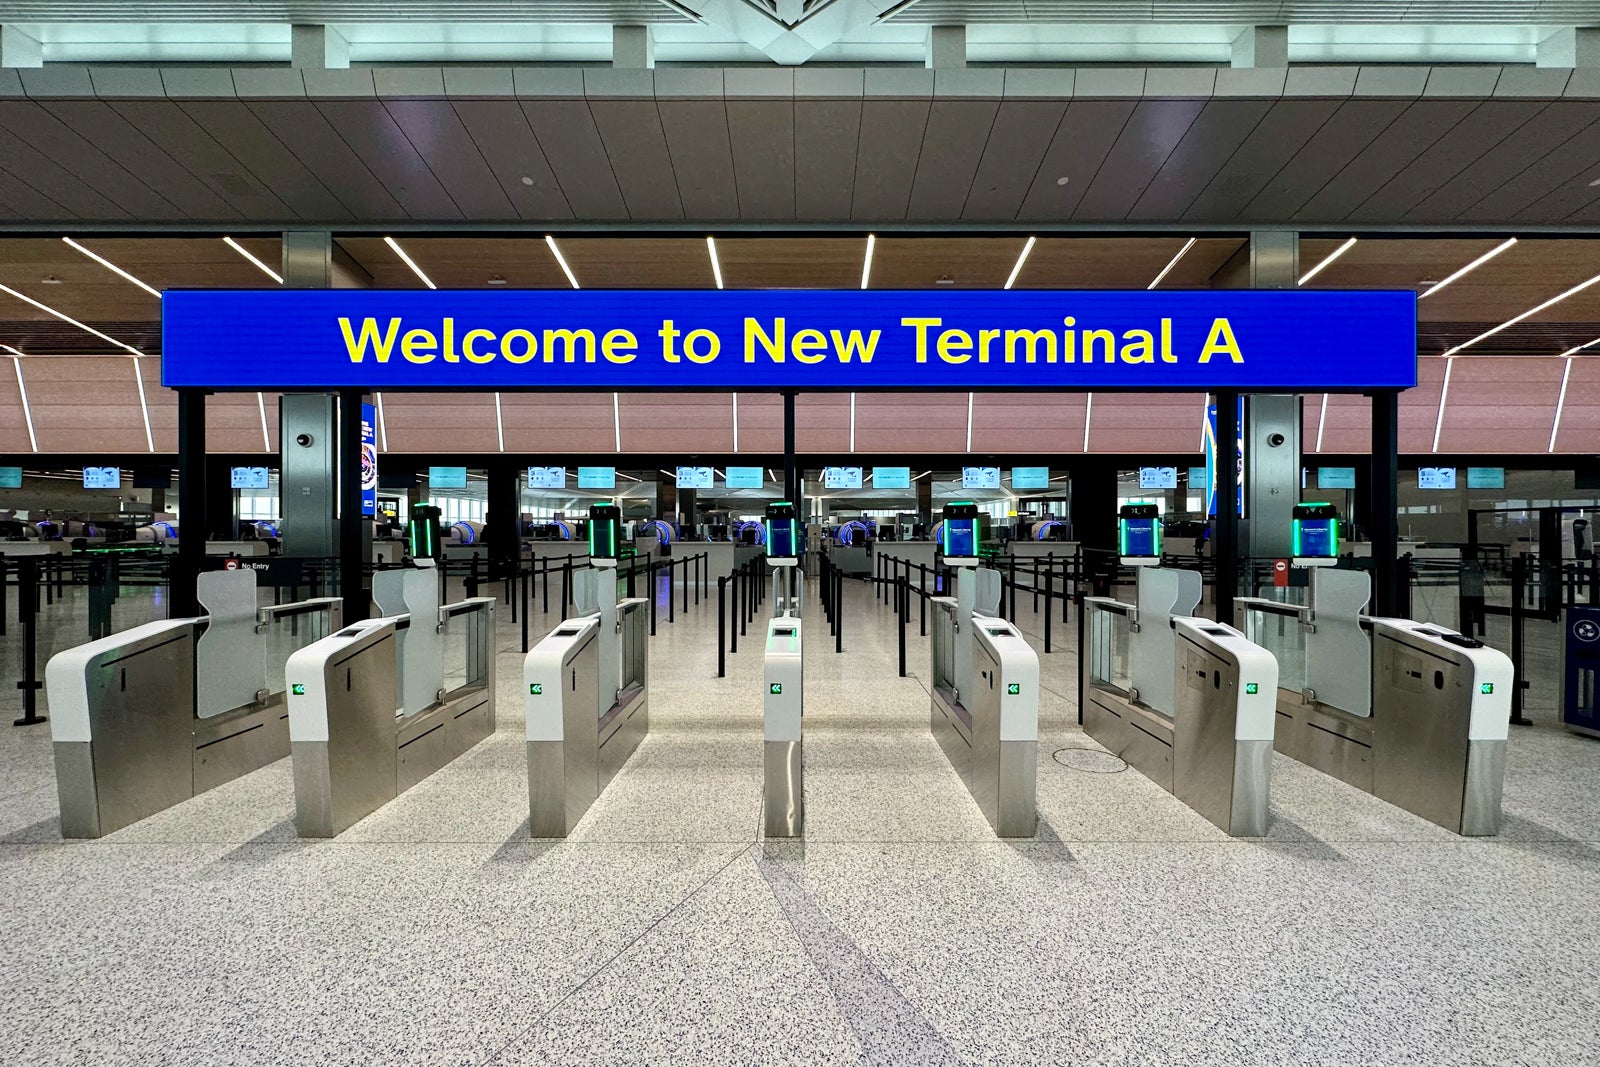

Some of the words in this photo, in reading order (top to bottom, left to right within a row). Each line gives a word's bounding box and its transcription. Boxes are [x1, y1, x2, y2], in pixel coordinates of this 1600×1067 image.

[338, 317, 638, 364] Welcome
[658, 319, 721, 364] to
[744, 317, 881, 364] New
[901, 316, 1178, 364] Terminal
[1198, 317, 1245, 364] A
[252, 563, 270, 571] Entry
